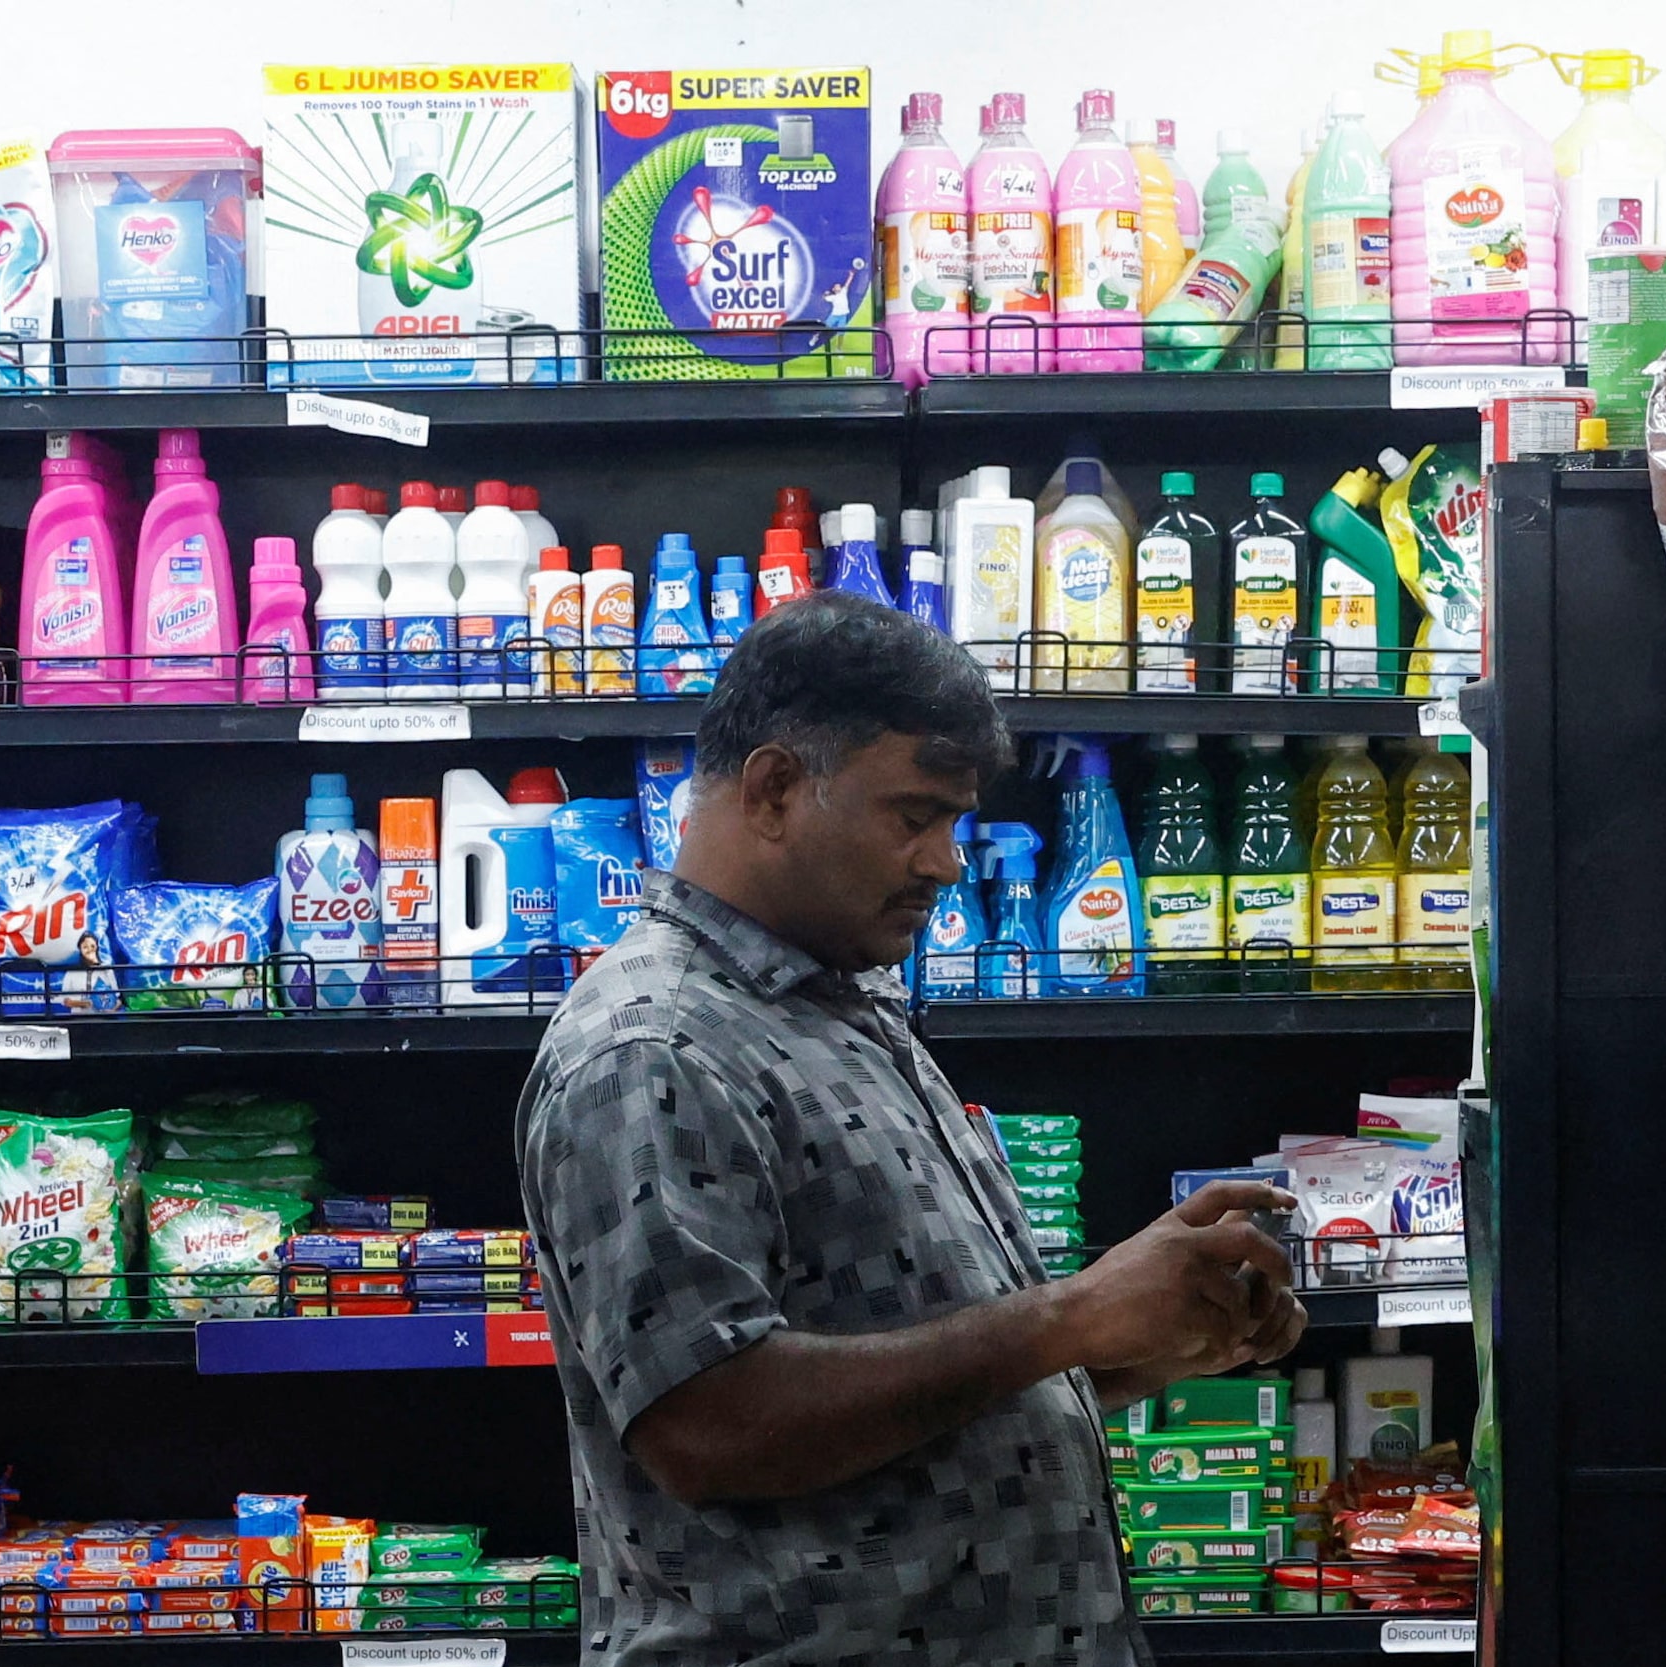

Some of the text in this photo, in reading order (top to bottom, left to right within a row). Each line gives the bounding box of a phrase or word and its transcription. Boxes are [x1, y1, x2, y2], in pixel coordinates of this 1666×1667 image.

[294, 70, 539, 91] 6 L JUMBO SAVER
[680, 77, 860, 99] SUPER SAVER
[305, 101, 358, 111] Removes
[361, 100, 382, 110] 100
[386, 99, 422, 111] Tough
[426, 99, 462, 110] Stains
[465, 98, 476, 110] in
[610, 80, 669, 118] 6kg
[758, 171, 836, 184] TOP LOAD
[121, 229, 174, 248] Henko
[712, 239, 790, 282] Surf
[712, 284, 785, 310] excel
[1401, 376, 1496, 393] Discount upto
[344, 409, 375, 427] upto
[405, 422, 422, 440] off
[41, 598, 94, 632] Vanish
[155, 598, 208, 632] Vanish
[306, 714, 458, 732] Discount upto 50% off
[391, 887, 425, 899] Savlon
[292, 894, 376, 923] Ezee
[934, 925, 965, 944] Colin
[172, 931, 245, 982] Rin
[5, 1034, 36, 1050] 50%
[39, 1034, 58, 1050] off
[1319, 1177, 1332, 1185] LG
[184, 1231, 248, 1254] Wheel
[487, 1246, 502, 1257] BIG
[364, 1249, 397, 1260] BIG BAR
[1383, 1299, 1445, 1314] Discount
[1151, 1452, 1174, 1474] Vim
[383, 1549, 408, 1565] EXO
[1149, 1543, 1172, 1566] Vim
[321, 1562, 334, 1608] MORE
[381, 1587, 405, 1602] EXO
[480, 1588, 505, 1605] EXO
[1387, 1628, 1447, 1641] Discount
[347, 1646, 498, 1662] Discount upto 50% off
